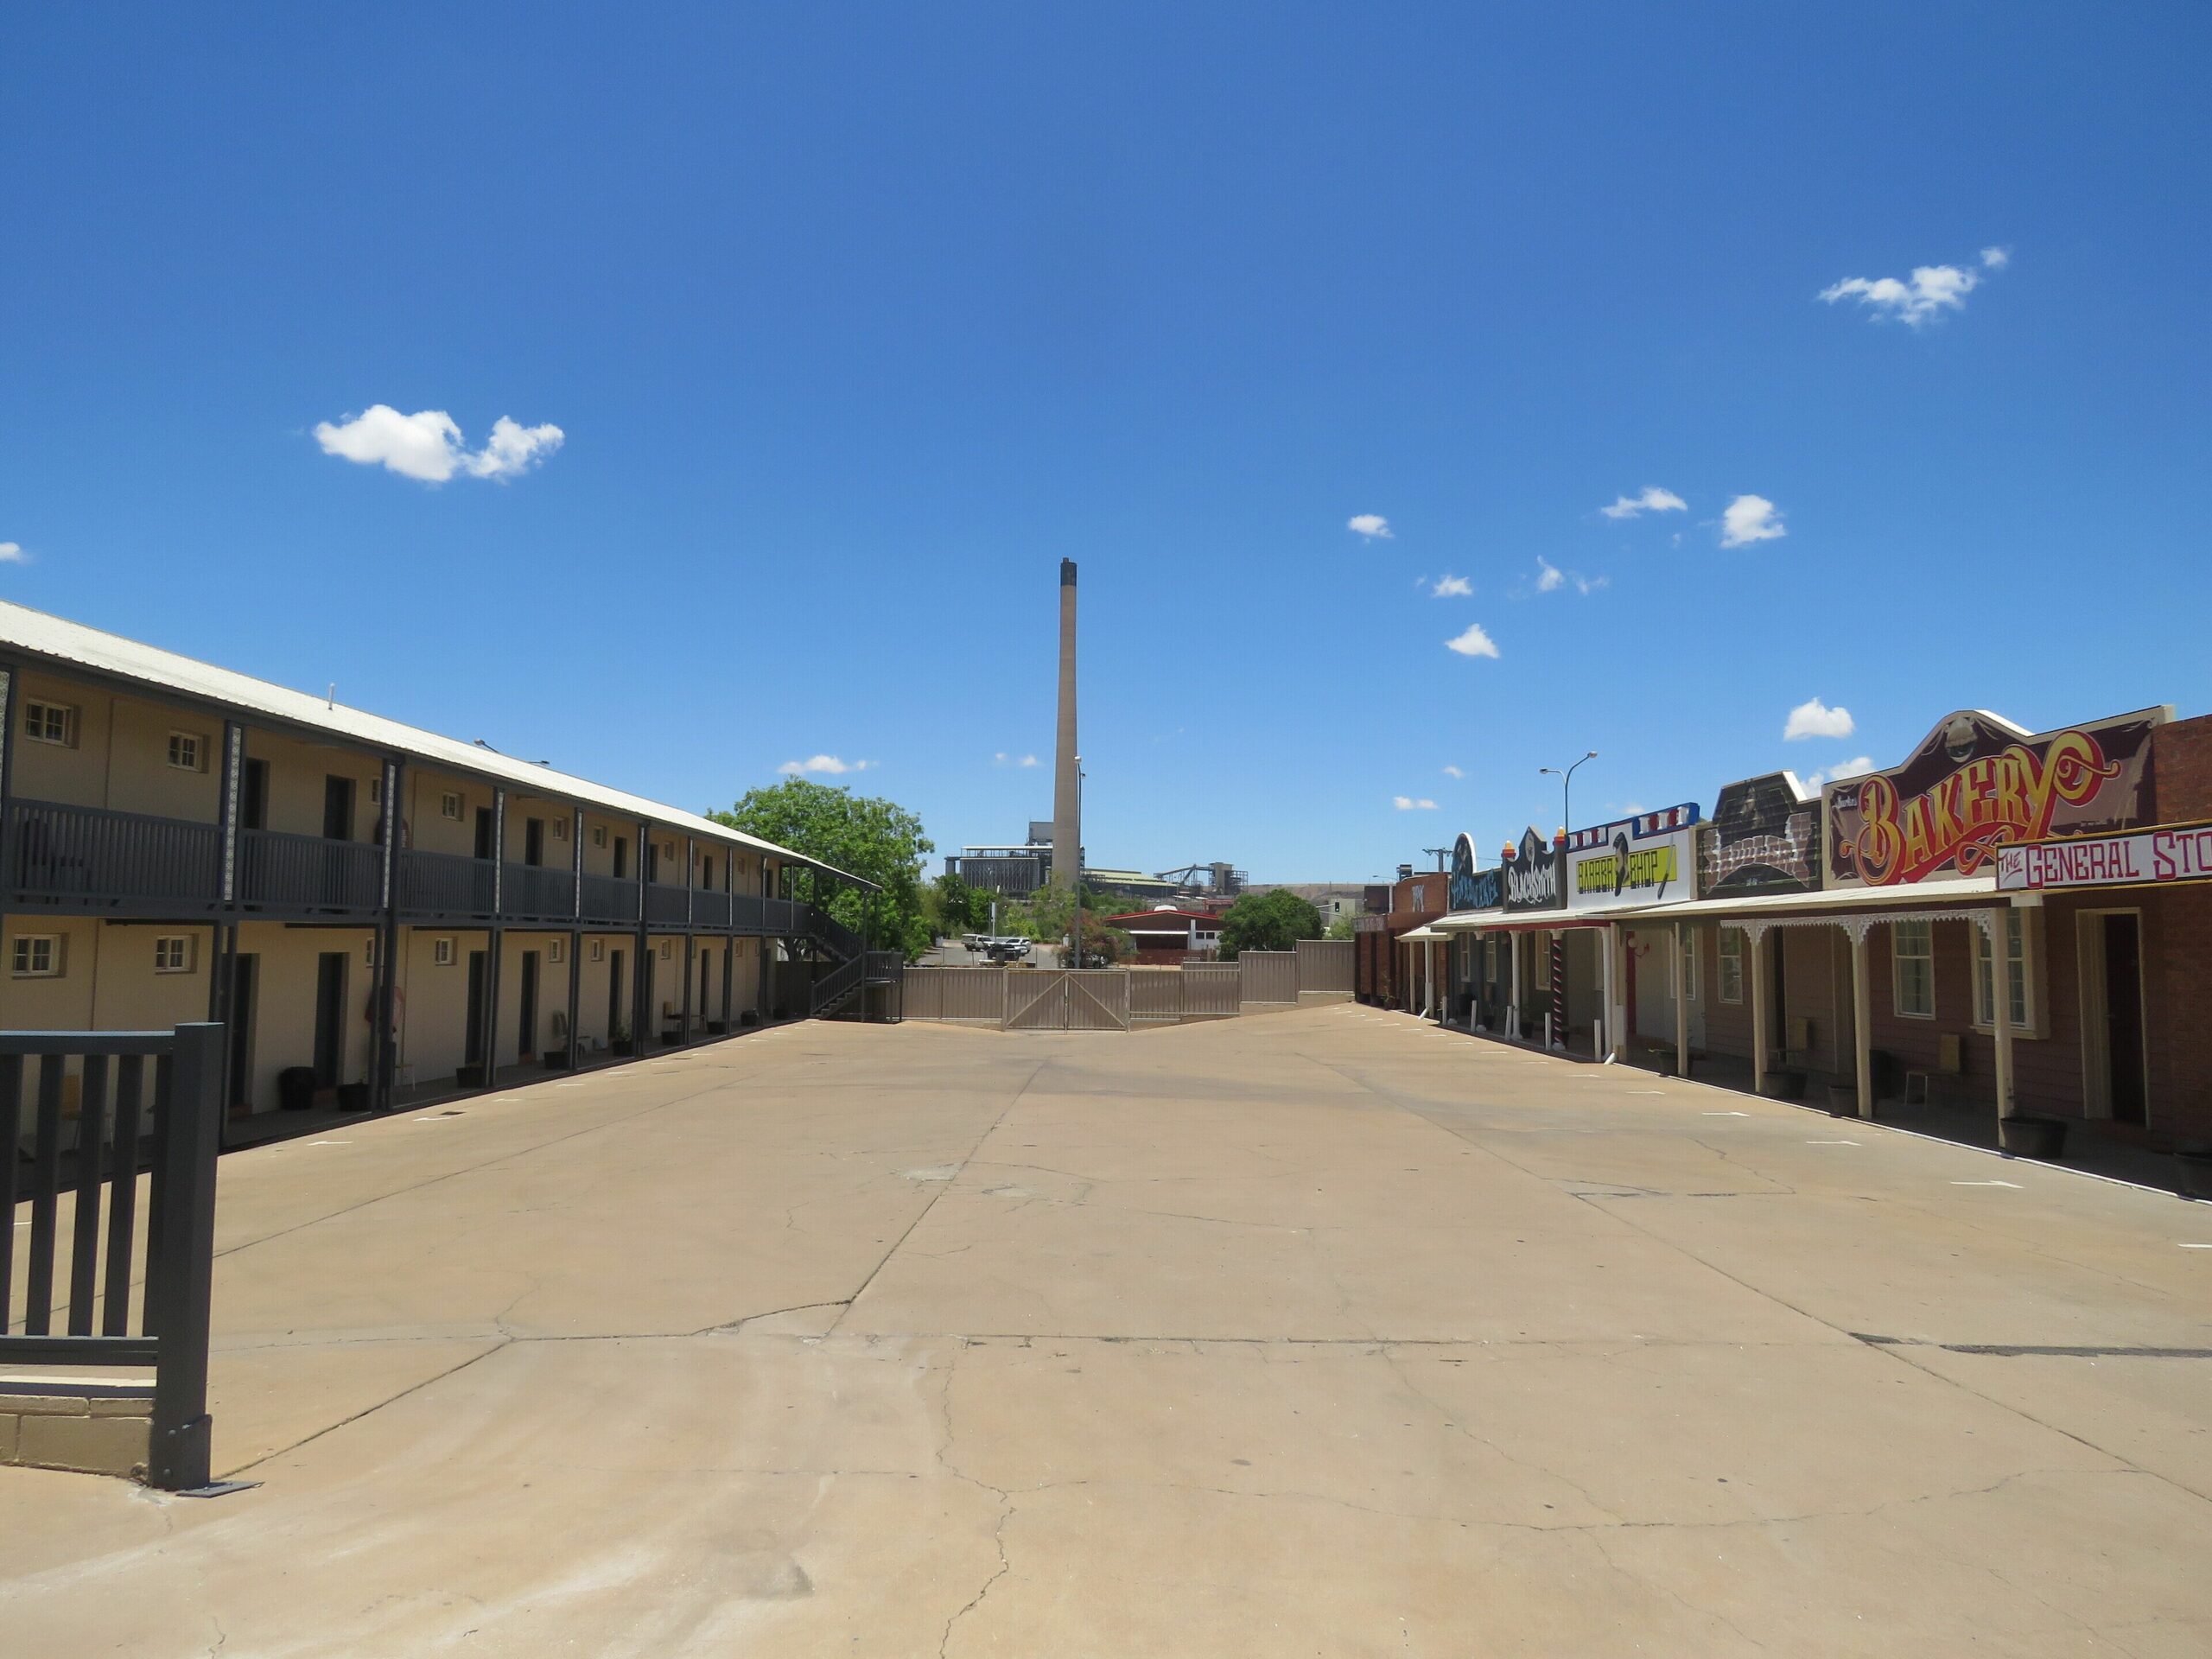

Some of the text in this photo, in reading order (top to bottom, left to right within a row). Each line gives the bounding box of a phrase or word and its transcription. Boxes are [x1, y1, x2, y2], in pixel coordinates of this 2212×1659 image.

[1839, 730, 2122, 886] BAKERY
[1508, 858, 1556, 905] BLACKSMITH
[1630, 850, 1658, 889] SHOP
[1999, 850, 2023, 874] THE
[2025, 840, 2139, 889] GENERAL
